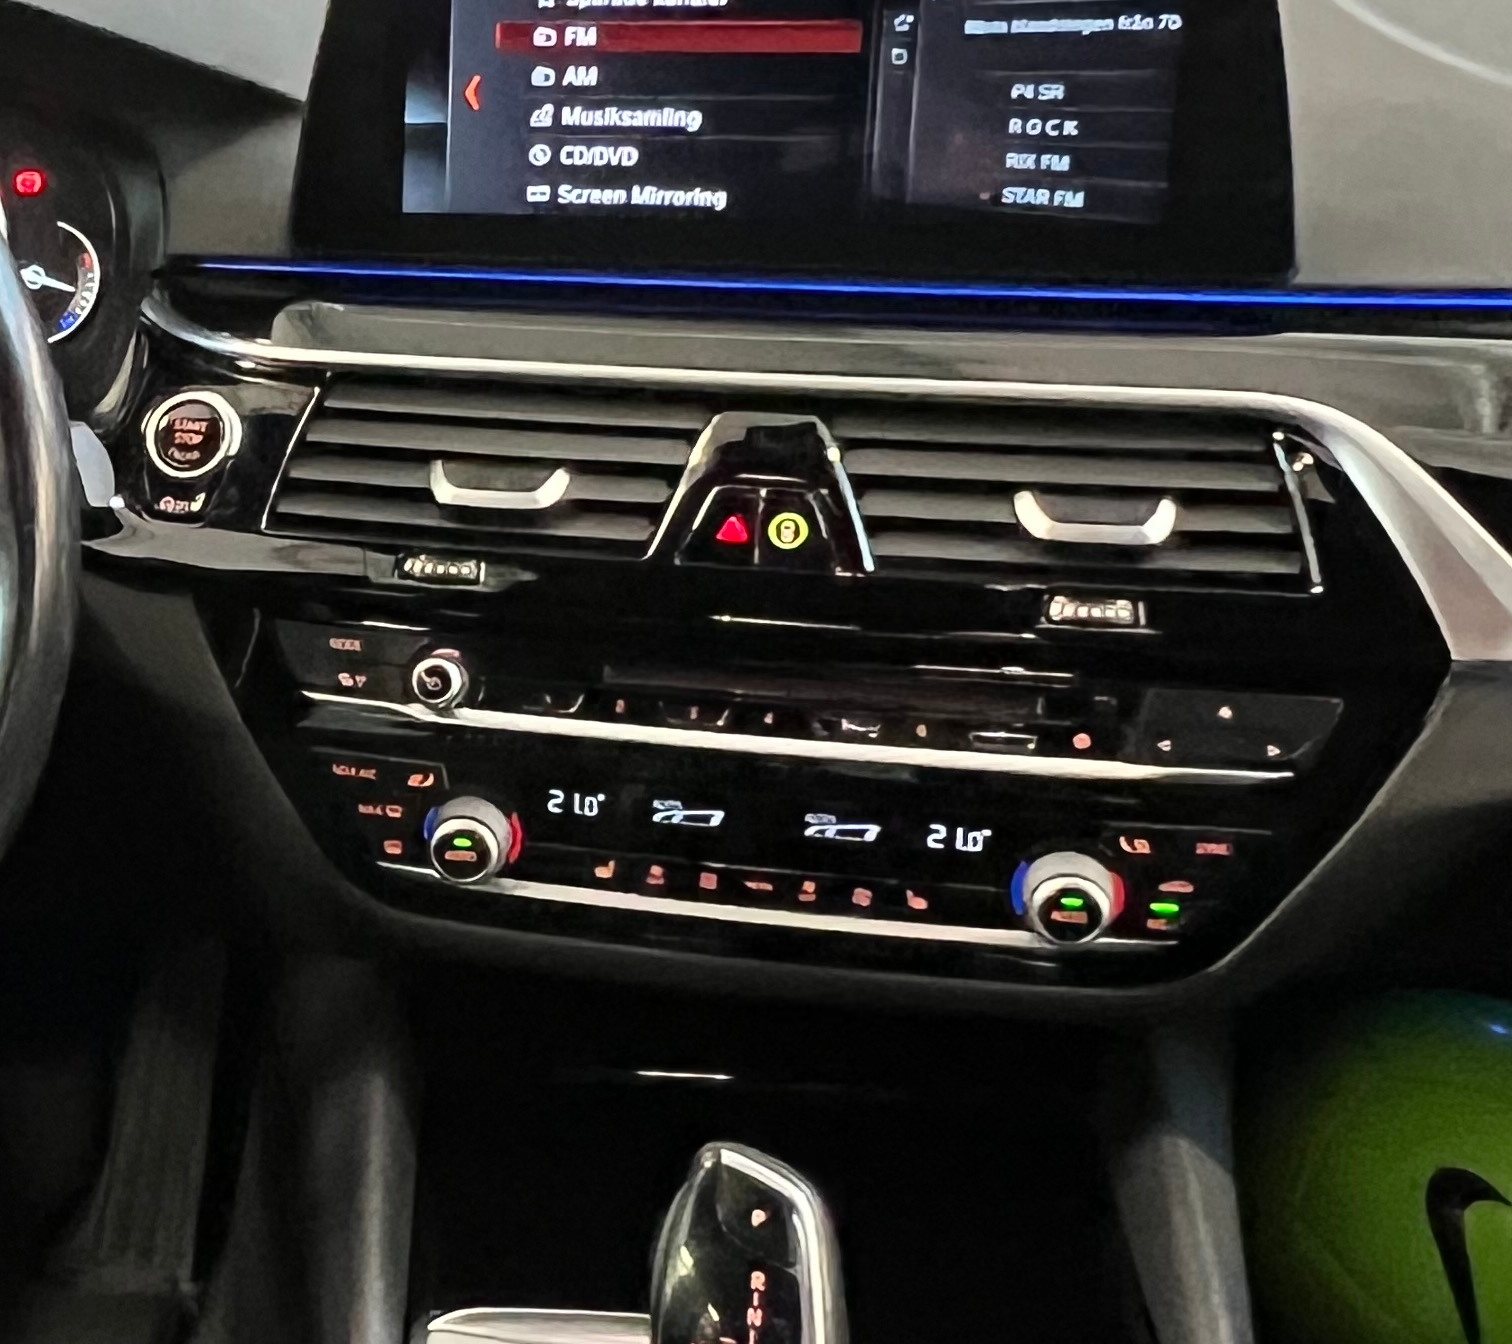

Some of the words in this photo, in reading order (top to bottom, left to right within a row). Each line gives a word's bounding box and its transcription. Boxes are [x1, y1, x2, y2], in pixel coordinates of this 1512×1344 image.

[564, 26, 598, 47] FM
[561, 66, 599, 87] AM
[561, 106, 703, 132] Musiksamling
[559, 145, 639, 167] CD/DVD
[557, 184, 627, 206] Screen
[631, 185, 728, 211] Mirroring
[1001, 187, 1050, 205] STAR
[1053, 190, 1085, 208] FM
